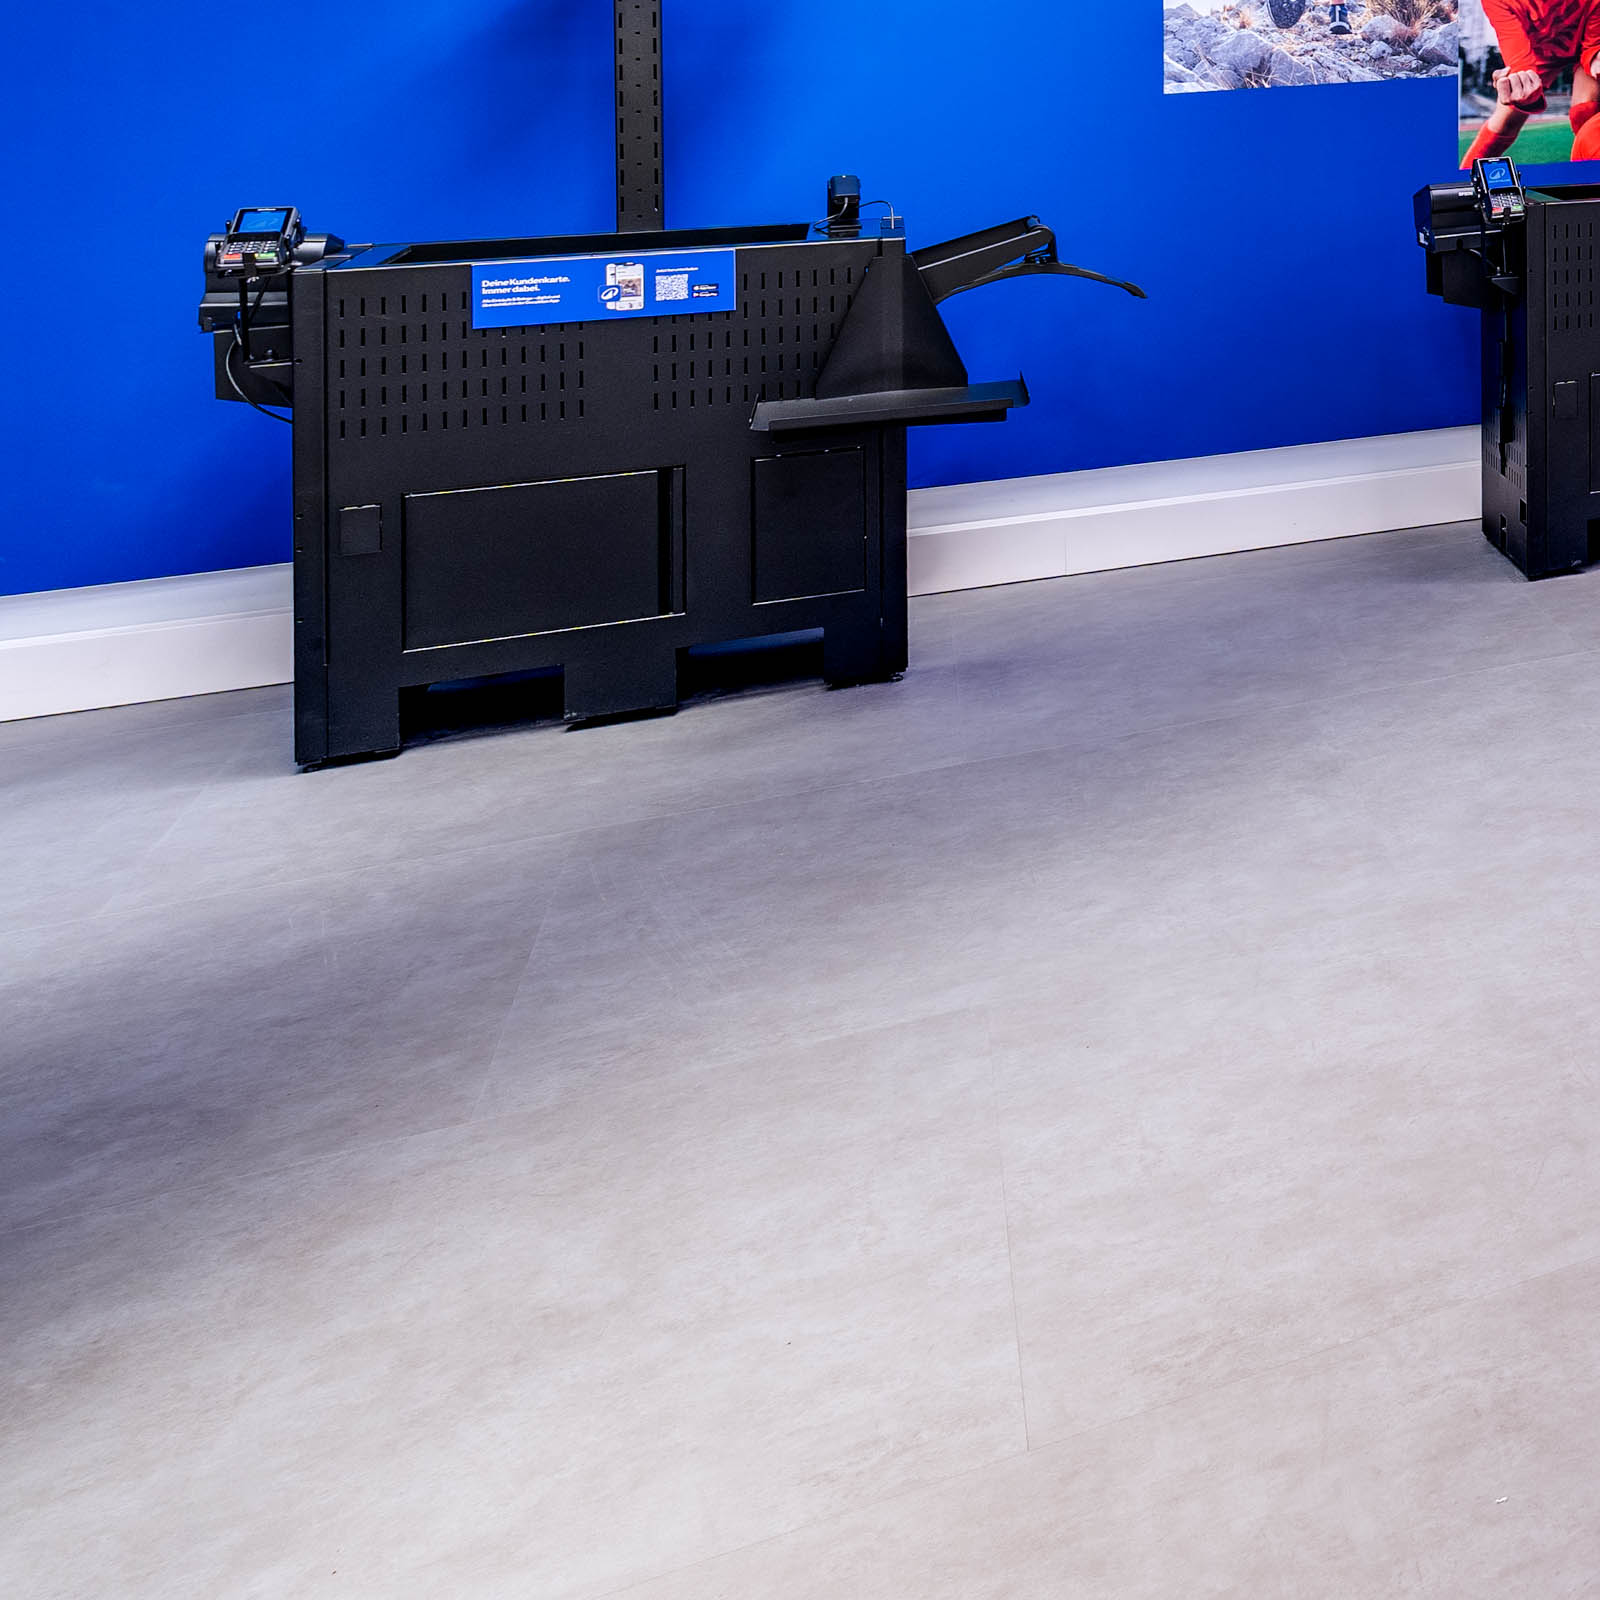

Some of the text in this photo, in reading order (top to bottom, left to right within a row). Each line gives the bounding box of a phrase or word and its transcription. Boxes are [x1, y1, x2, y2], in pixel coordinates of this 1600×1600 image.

[481, 276, 570, 288] Deine Kundenkarte.
[512, 284, 541, 293] dabei.
